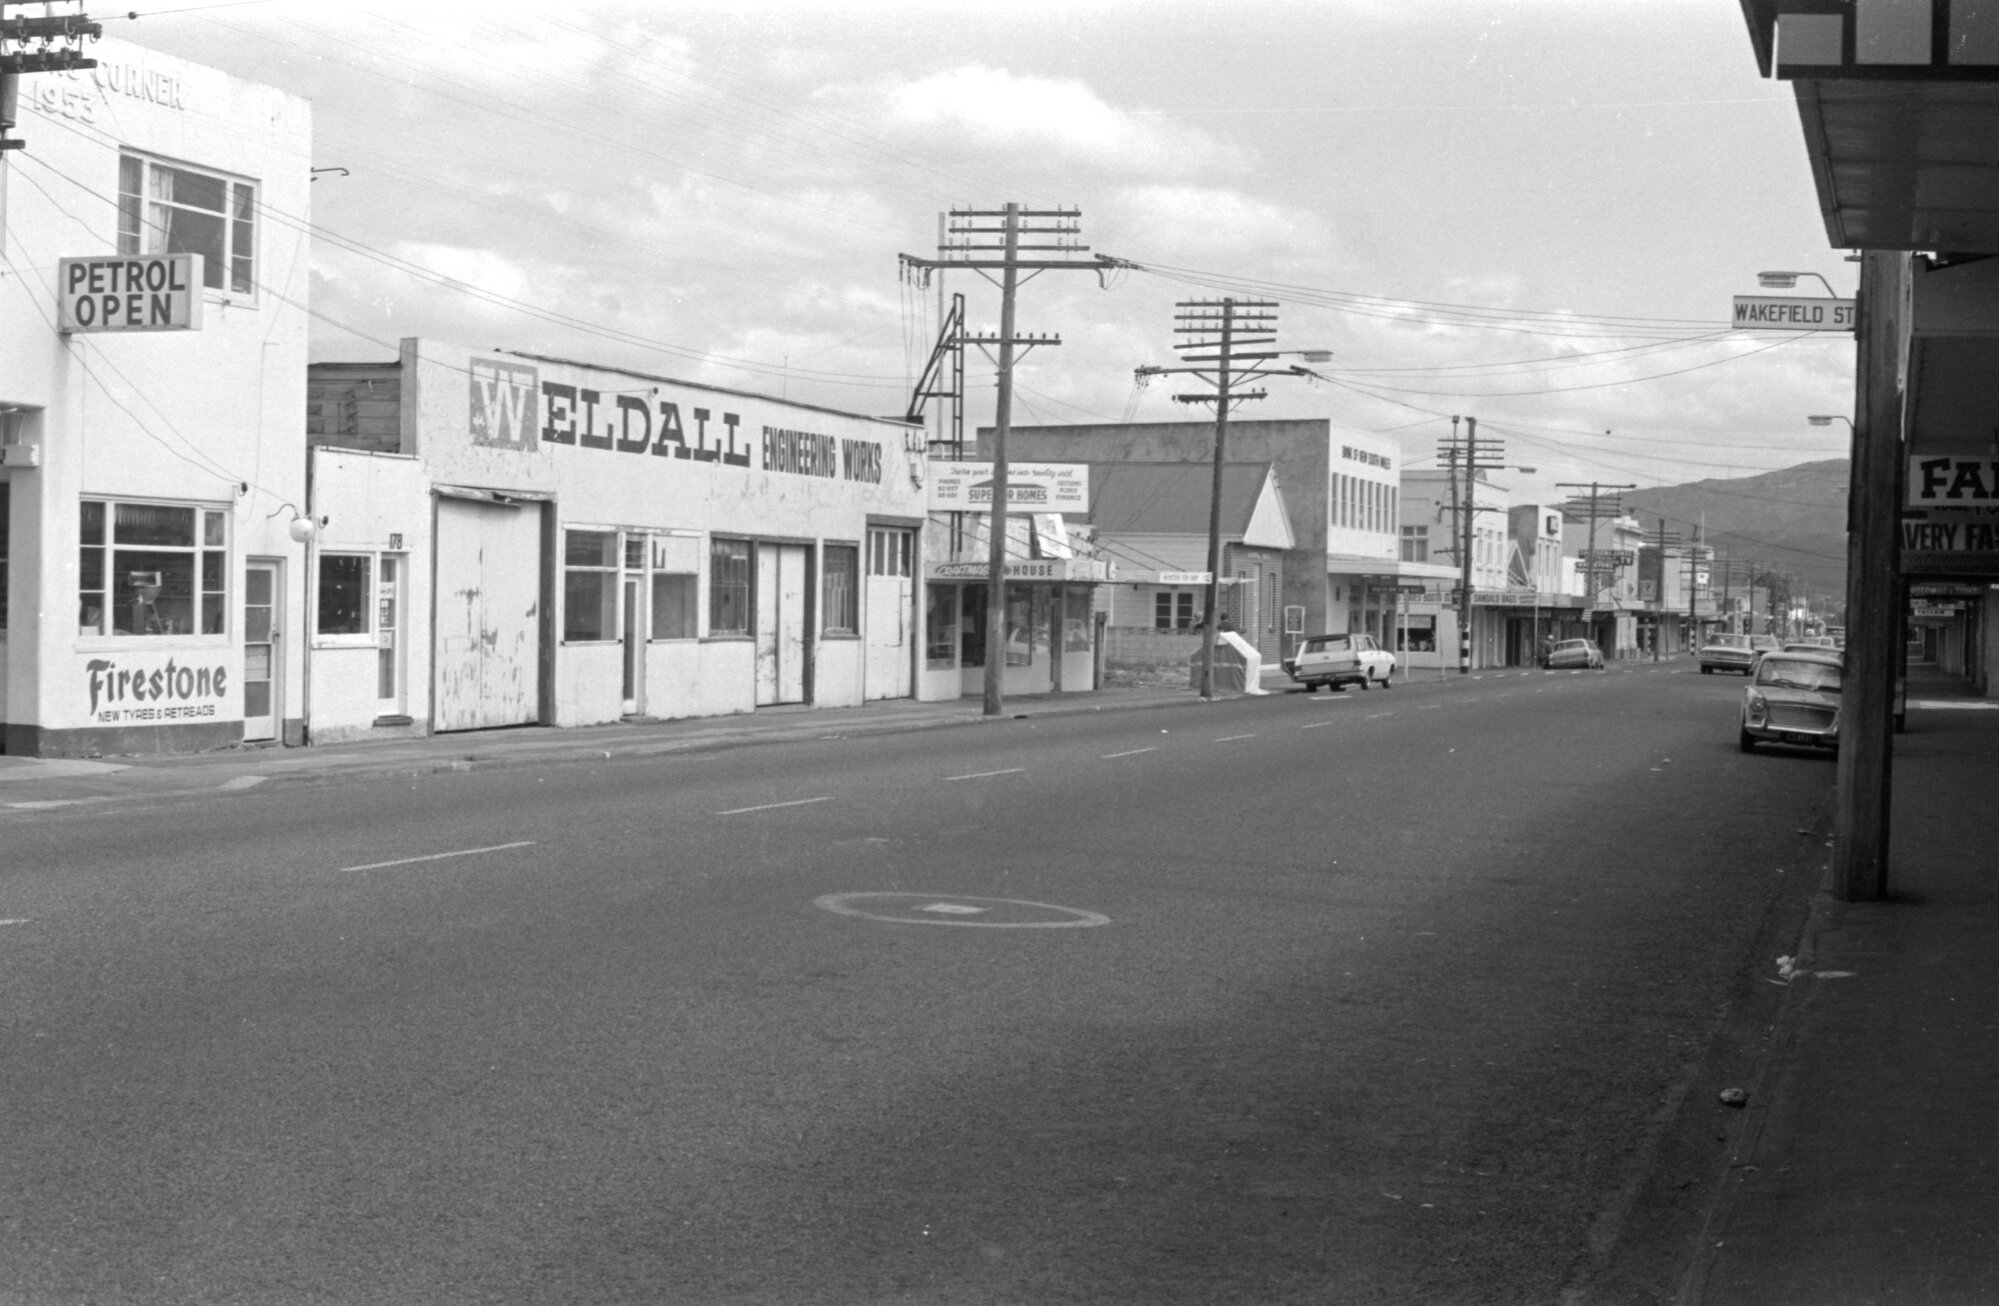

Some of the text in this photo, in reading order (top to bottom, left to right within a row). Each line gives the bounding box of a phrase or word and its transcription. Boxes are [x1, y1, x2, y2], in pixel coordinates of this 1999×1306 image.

[93, 60, 185, 111] CORNER
[68, 259, 186, 295] PETROL
[74, 294, 172, 327] OPEN
[1735, 303, 1854, 325] WAKEFIELD ST
[473, 364, 882, 485] WELDALL ENGINEERING WORKS
[968, 488, 1015, 501] SUPER
[1016, 489, 1048, 501] HOMES
[1013, 564, 1054, 577] HOUSE
[86, 656, 227, 716] Firestone
[98, 704, 215, 723] NEW TYRES & RETREADS
